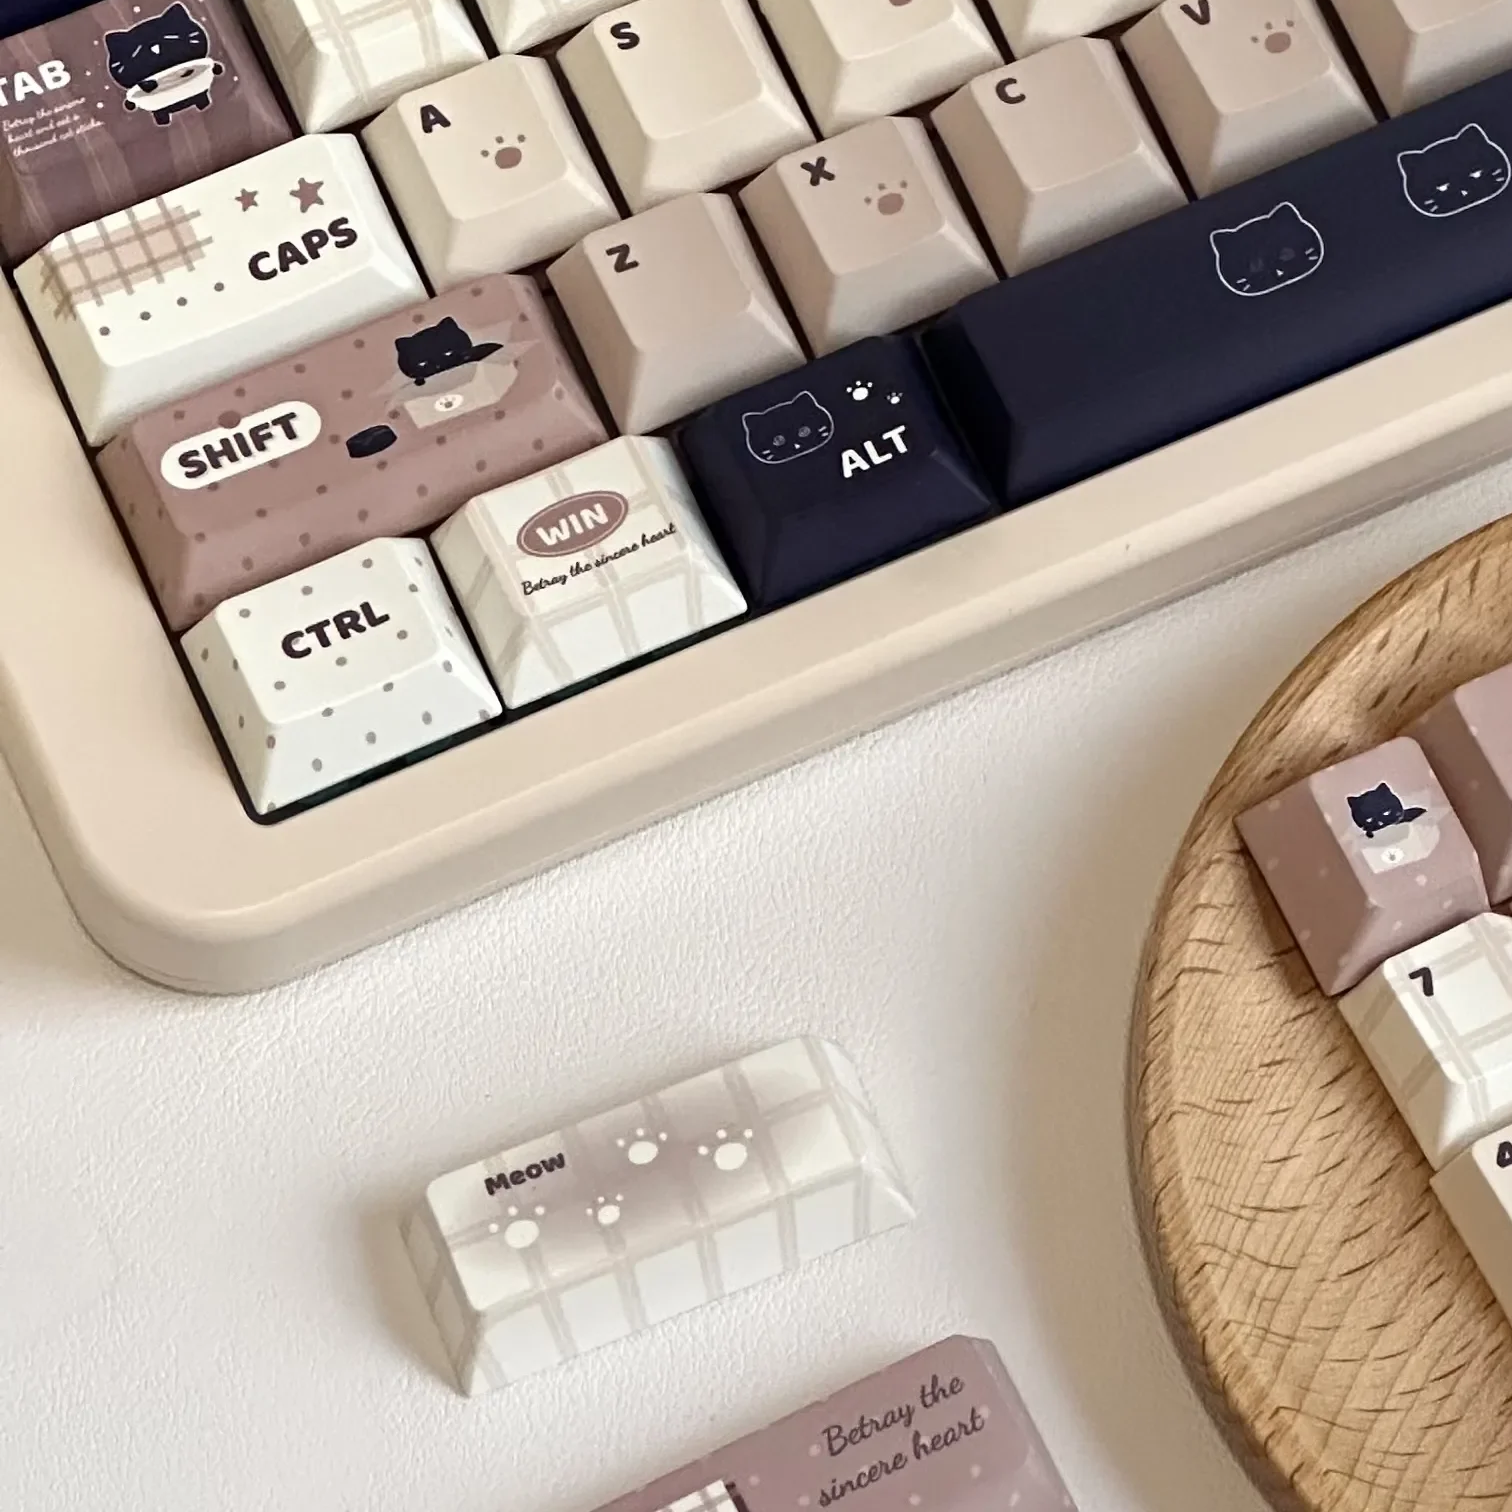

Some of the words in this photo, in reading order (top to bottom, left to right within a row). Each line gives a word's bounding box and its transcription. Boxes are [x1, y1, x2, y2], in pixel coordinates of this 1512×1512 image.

[610, 21, 640, 50] S
[995, 77, 1026, 105] C
[420, 104, 452, 134] A
[800, 156, 836, 187] X
[248, 216, 358, 281] CAPS
[605, 243, 640, 273] Z
[178, 411, 298, 478] SHIFT
[841, 425, 908, 479] ALT
[535, 503, 609, 546] WIN
[281, 601, 390, 659] CTRL
[1408, 966, 1434, 997] 7
[484, 1152, 566, 1196] Meow
